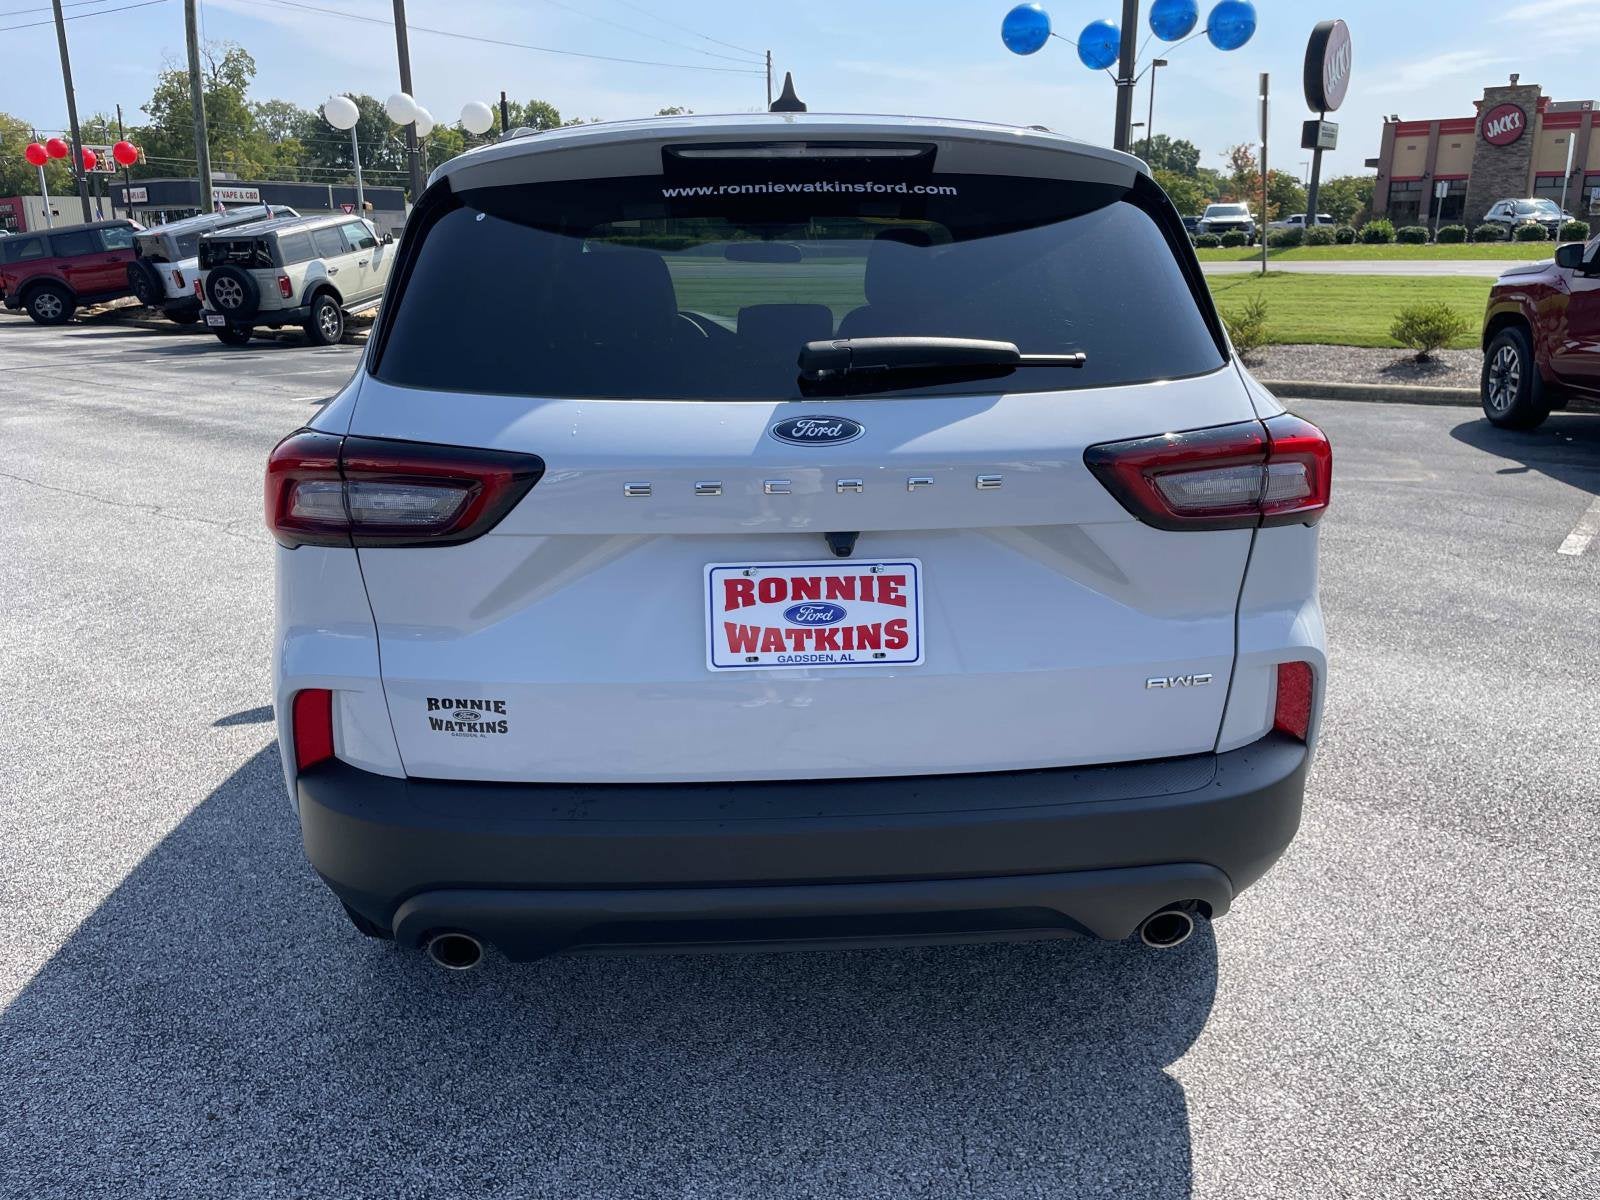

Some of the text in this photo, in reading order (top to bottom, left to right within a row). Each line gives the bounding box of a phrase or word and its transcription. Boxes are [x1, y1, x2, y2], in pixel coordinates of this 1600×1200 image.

[1487, 112, 1520, 137] JACK'S
[221, 190, 238, 199] VAPE
[245, 191, 258, 200] CBD
[662, 181, 957, 197] www.ronniewatkinsford.com
[791, 419, 843, 437] Ford
[624, 473, 1003, 497] ESCAPE
[724, 575, 907, 611] RONNIE
[796, 605, 834, 621] Ford
[724, 618, 909, 654] WATKINS
[777, 652, 855, 664] GADSDEN, AL
[1145, 673, 1213, 689] AWD
[426, 697, 507, 715] RONNIE
[428, 716, 509, 734] WATKINS
